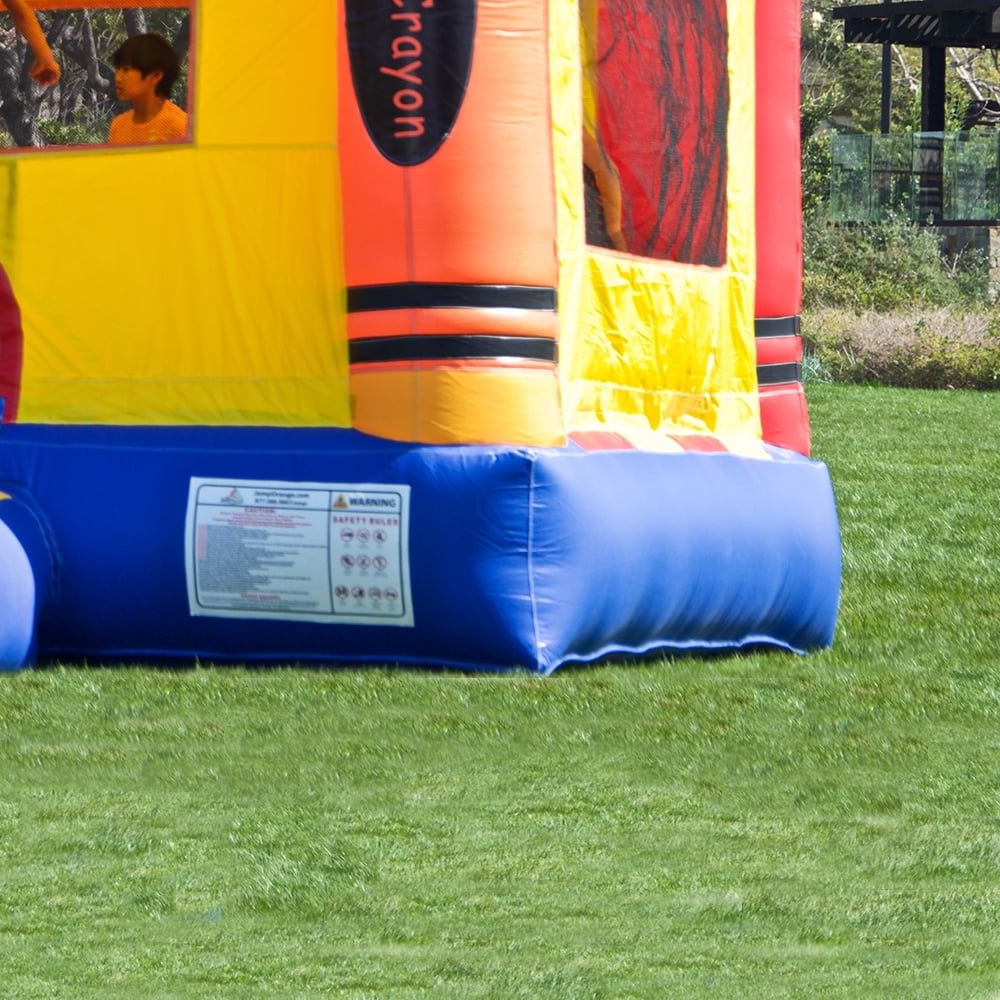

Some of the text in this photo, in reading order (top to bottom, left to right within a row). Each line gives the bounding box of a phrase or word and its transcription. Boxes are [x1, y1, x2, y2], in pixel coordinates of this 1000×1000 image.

[349, 497, 397, 508] WARNING
[333, 516, 398, 526] SAFETY RULES
